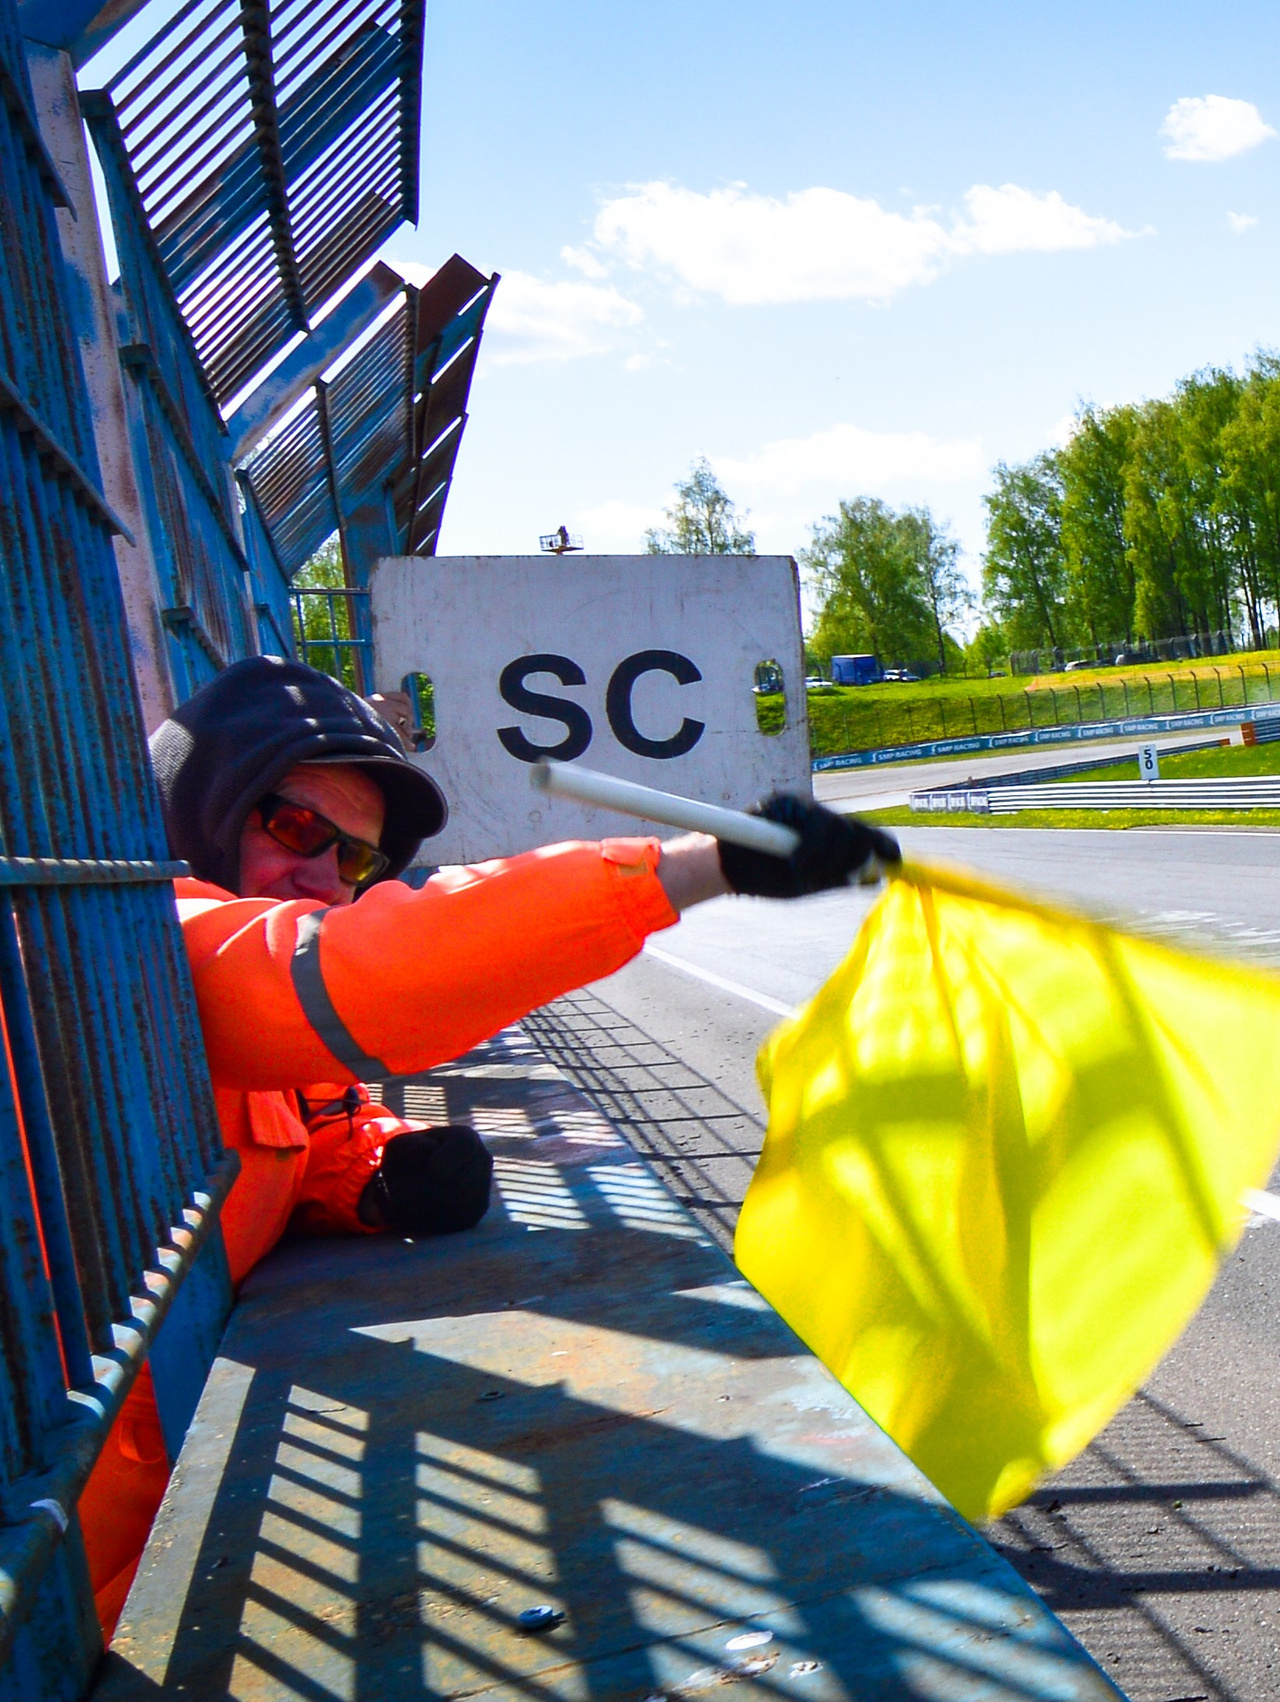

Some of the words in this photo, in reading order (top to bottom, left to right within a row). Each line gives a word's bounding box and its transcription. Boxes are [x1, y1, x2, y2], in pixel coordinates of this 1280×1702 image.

[497, 649, 705, 763] SC
[954, 742, 980, 751] RACING
[895, 748, 922, 758] RACING
[835, 757, 862, 767] RACING
[1144, 749, 1153, 770] 50
